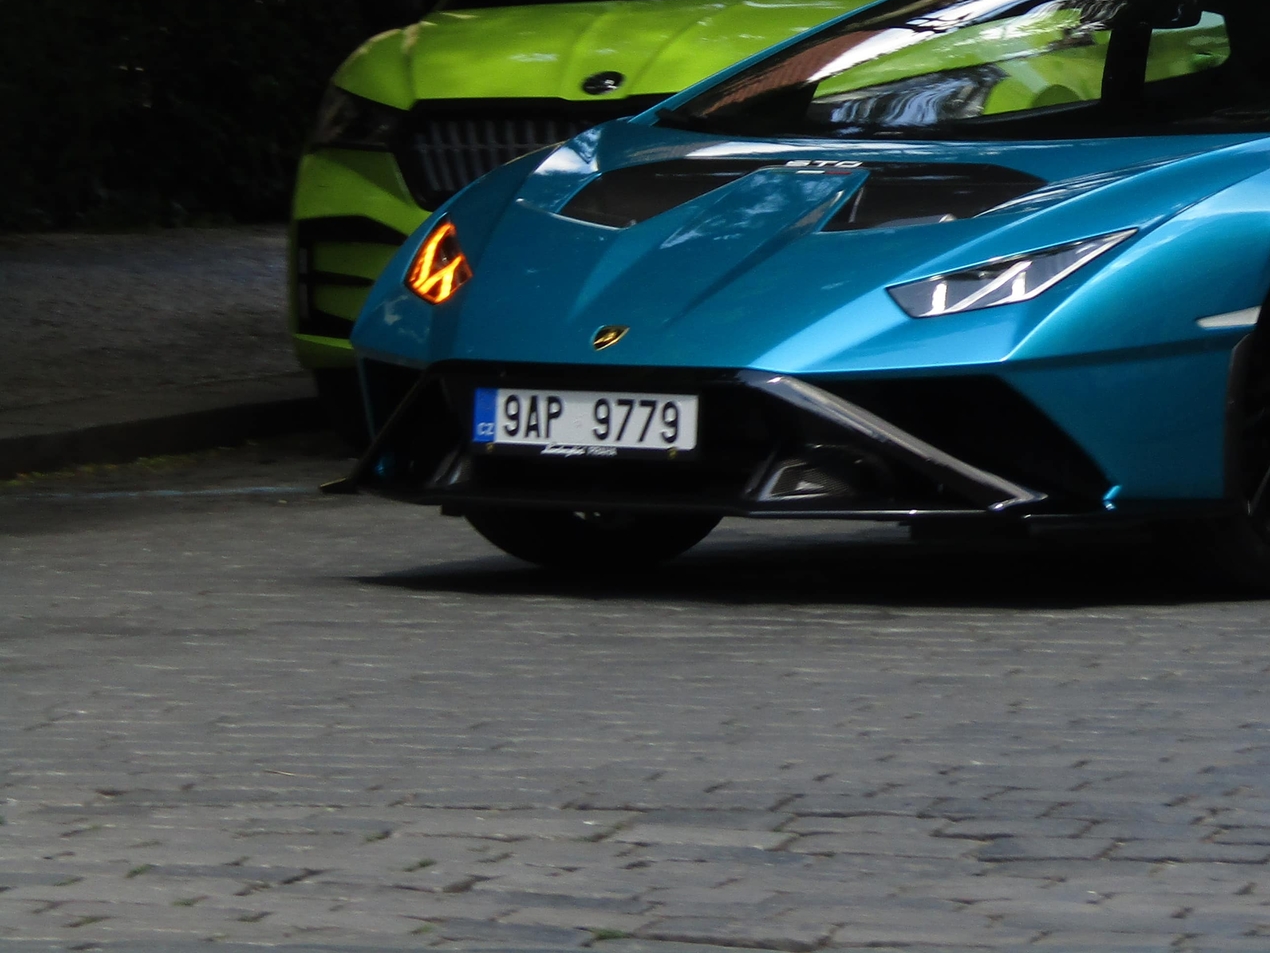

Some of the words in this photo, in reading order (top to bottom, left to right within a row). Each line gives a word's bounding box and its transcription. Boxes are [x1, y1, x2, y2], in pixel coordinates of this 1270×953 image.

[477, 422, 495, 436] CZ
[502, 394, 564, 439] 9AP
[592, 397, 680, 443] 9779
